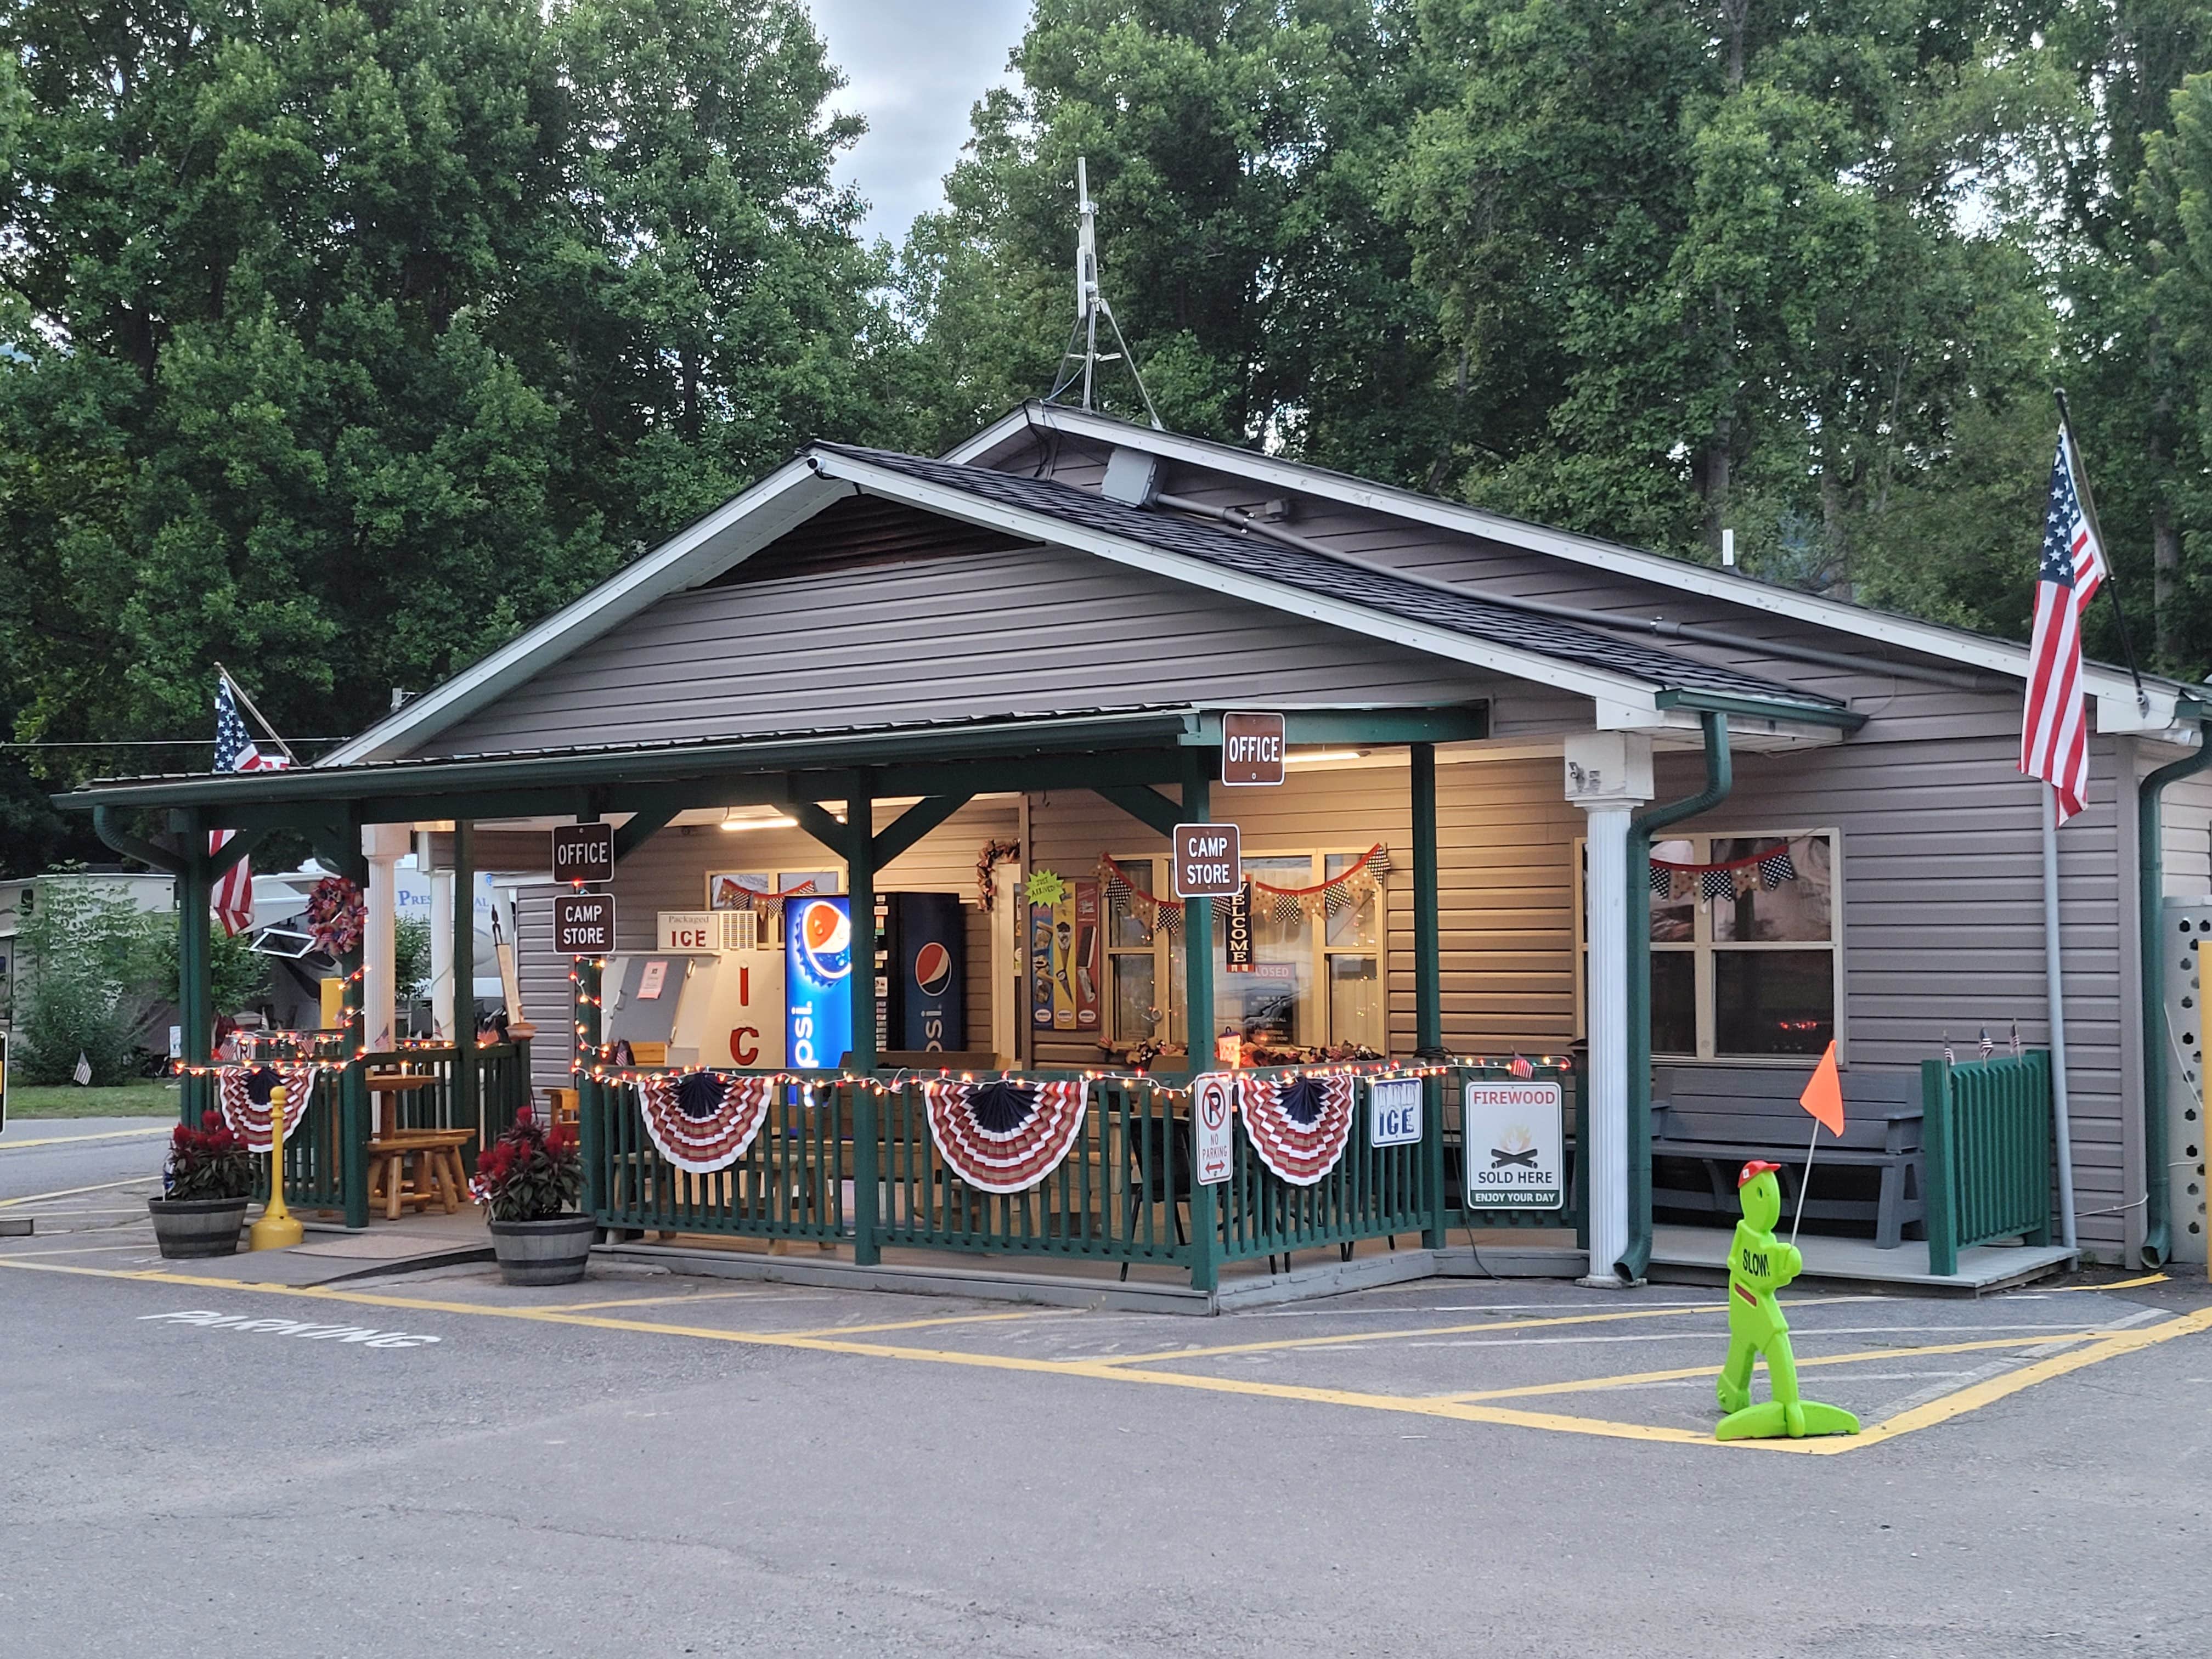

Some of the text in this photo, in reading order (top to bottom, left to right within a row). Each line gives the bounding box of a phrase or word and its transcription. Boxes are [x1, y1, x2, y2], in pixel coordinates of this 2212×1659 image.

[1228, 736, 1279, 763] OFFICE
[557, 842, 608, 865] OFFICE
[1188, 837, 1228, 857] CAMP
[1187, 864, 1230, 885] STORE
[565, 905, 602, 923] CAMP
[563, 927, 605, 945] STORE
[672, 930, 706, 947] ICE
[1255, 967, 1289, 978] LOSED
[1474, 1091, 1555, 1104] FIREWOOD
[1379, 1106, 1414, 1137] ICE
[1210, 1133, 1218, 1145] NO
[1203, 1146, 1227, 1161] PARKING
[1478, 1172, 1552, 1183] SOLD HERE
[1475, 1193, 1555, 1202] ENJOY YOUR DAY
[1742, 1249, 1770, 1277] SLOW!
[138, 1310, 442, 1348] PARKING
